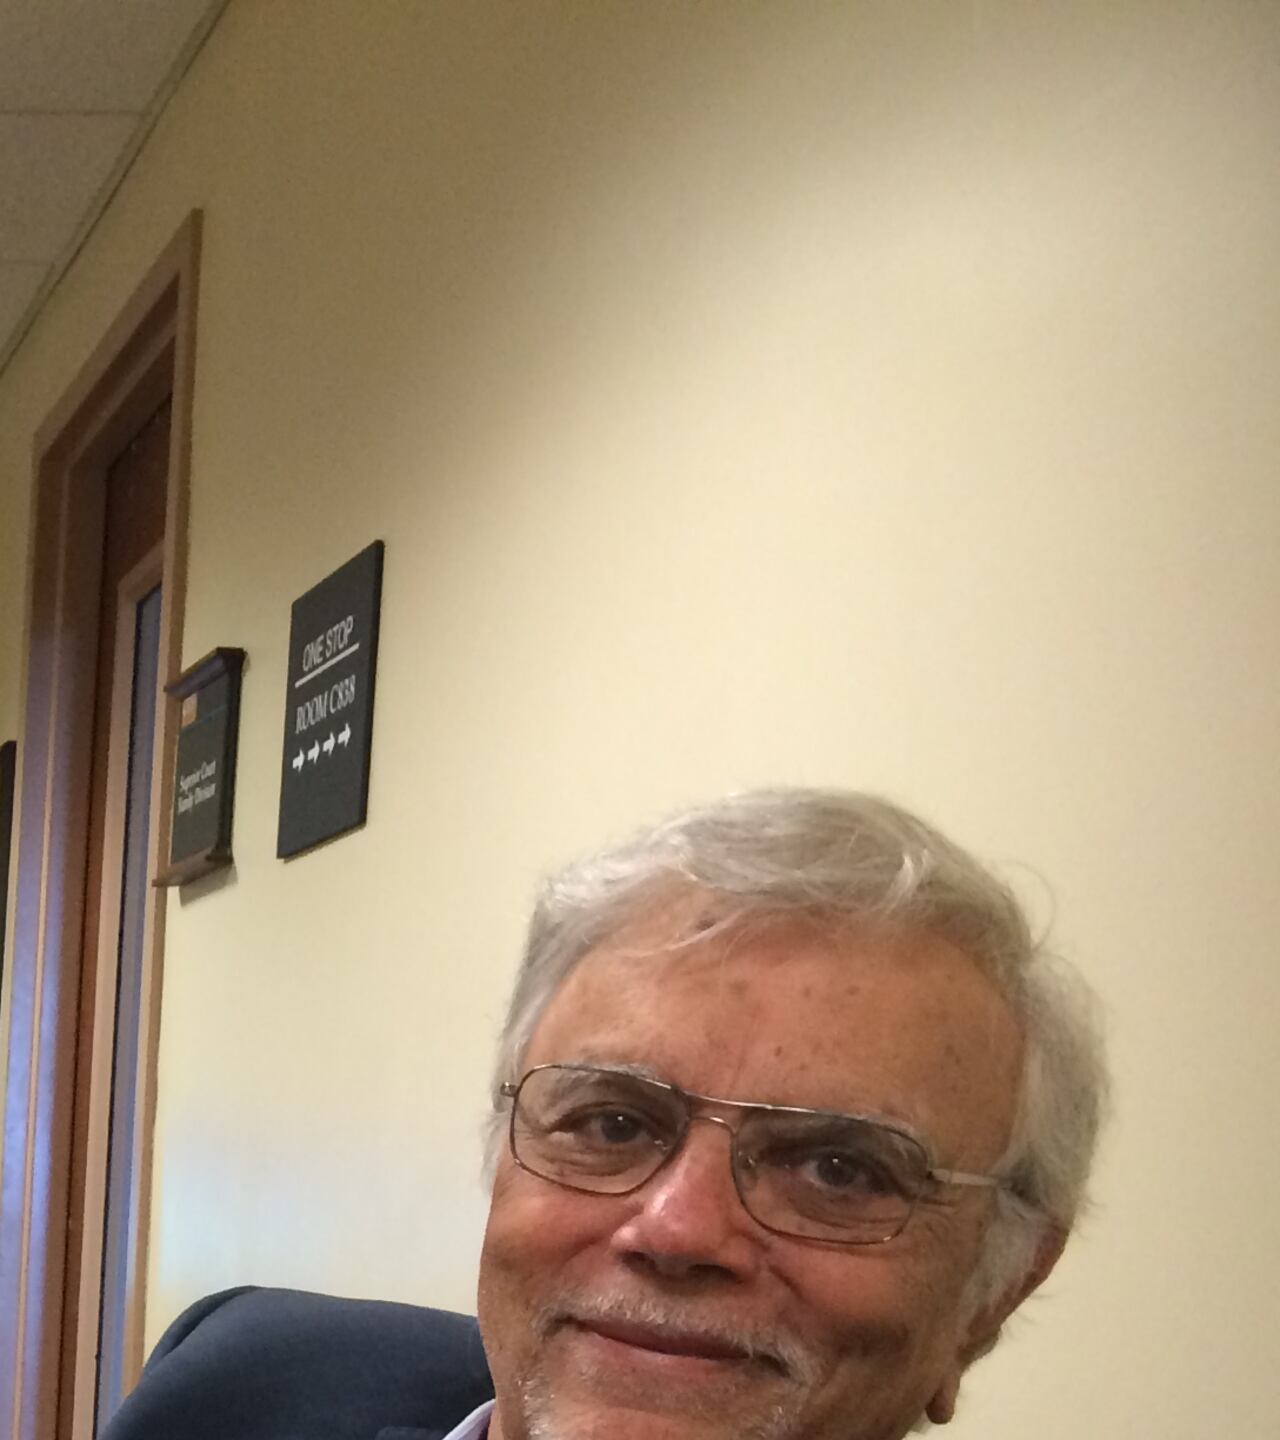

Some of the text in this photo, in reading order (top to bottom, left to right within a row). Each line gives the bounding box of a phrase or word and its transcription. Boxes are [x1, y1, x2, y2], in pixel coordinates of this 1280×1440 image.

[302, 615, 354, 672] ONE STOP
[295, 691, 329, 735] ROOM
